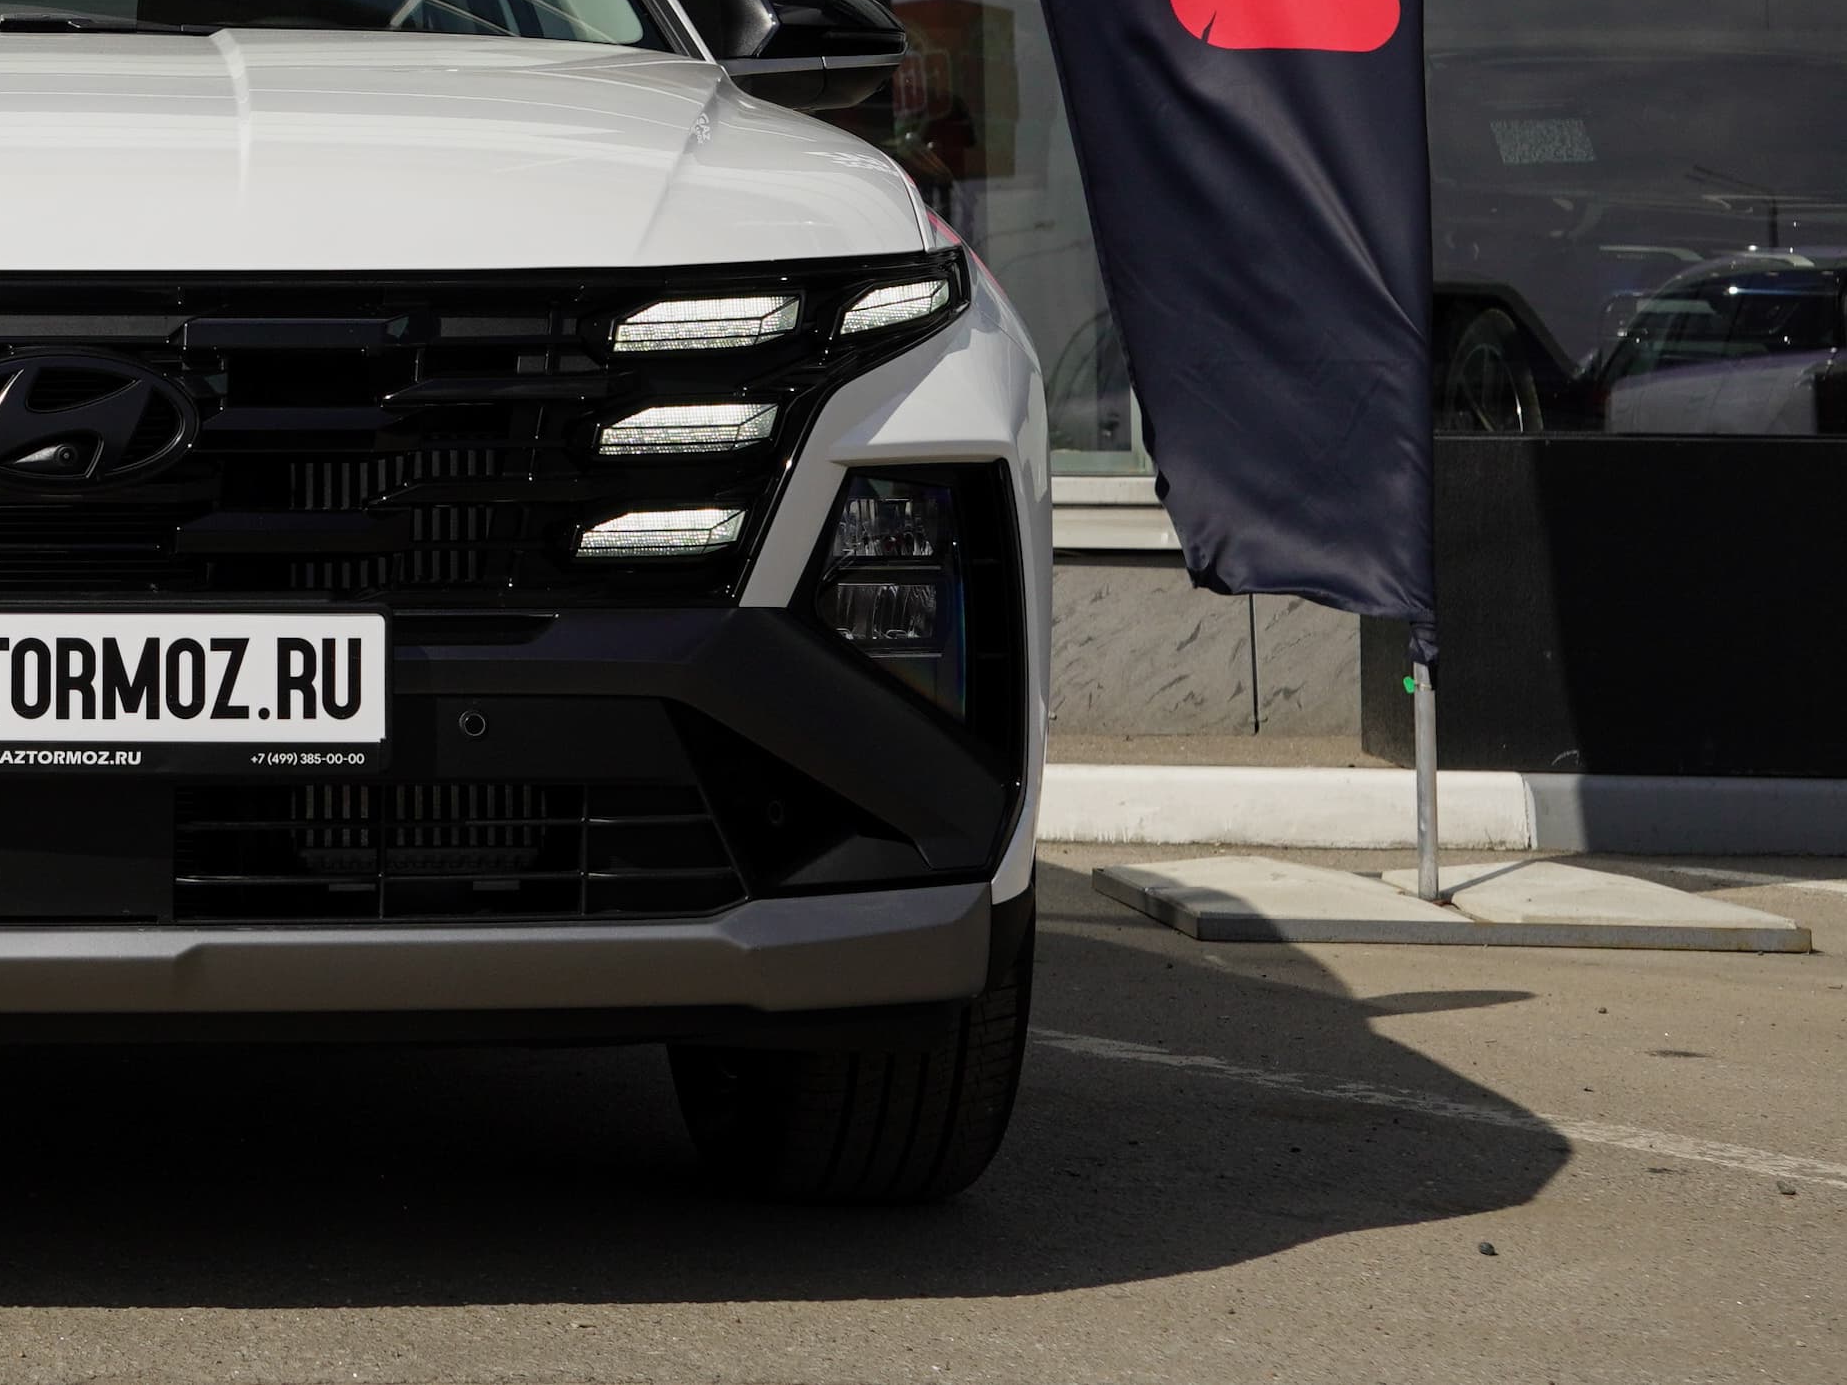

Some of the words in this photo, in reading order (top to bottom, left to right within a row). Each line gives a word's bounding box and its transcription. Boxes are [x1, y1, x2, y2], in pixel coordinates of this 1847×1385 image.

[250, 752, 265, 766] +7
[267, 751, 298, 766] (499)
[300, 752, 365, 765] 385-00-00
